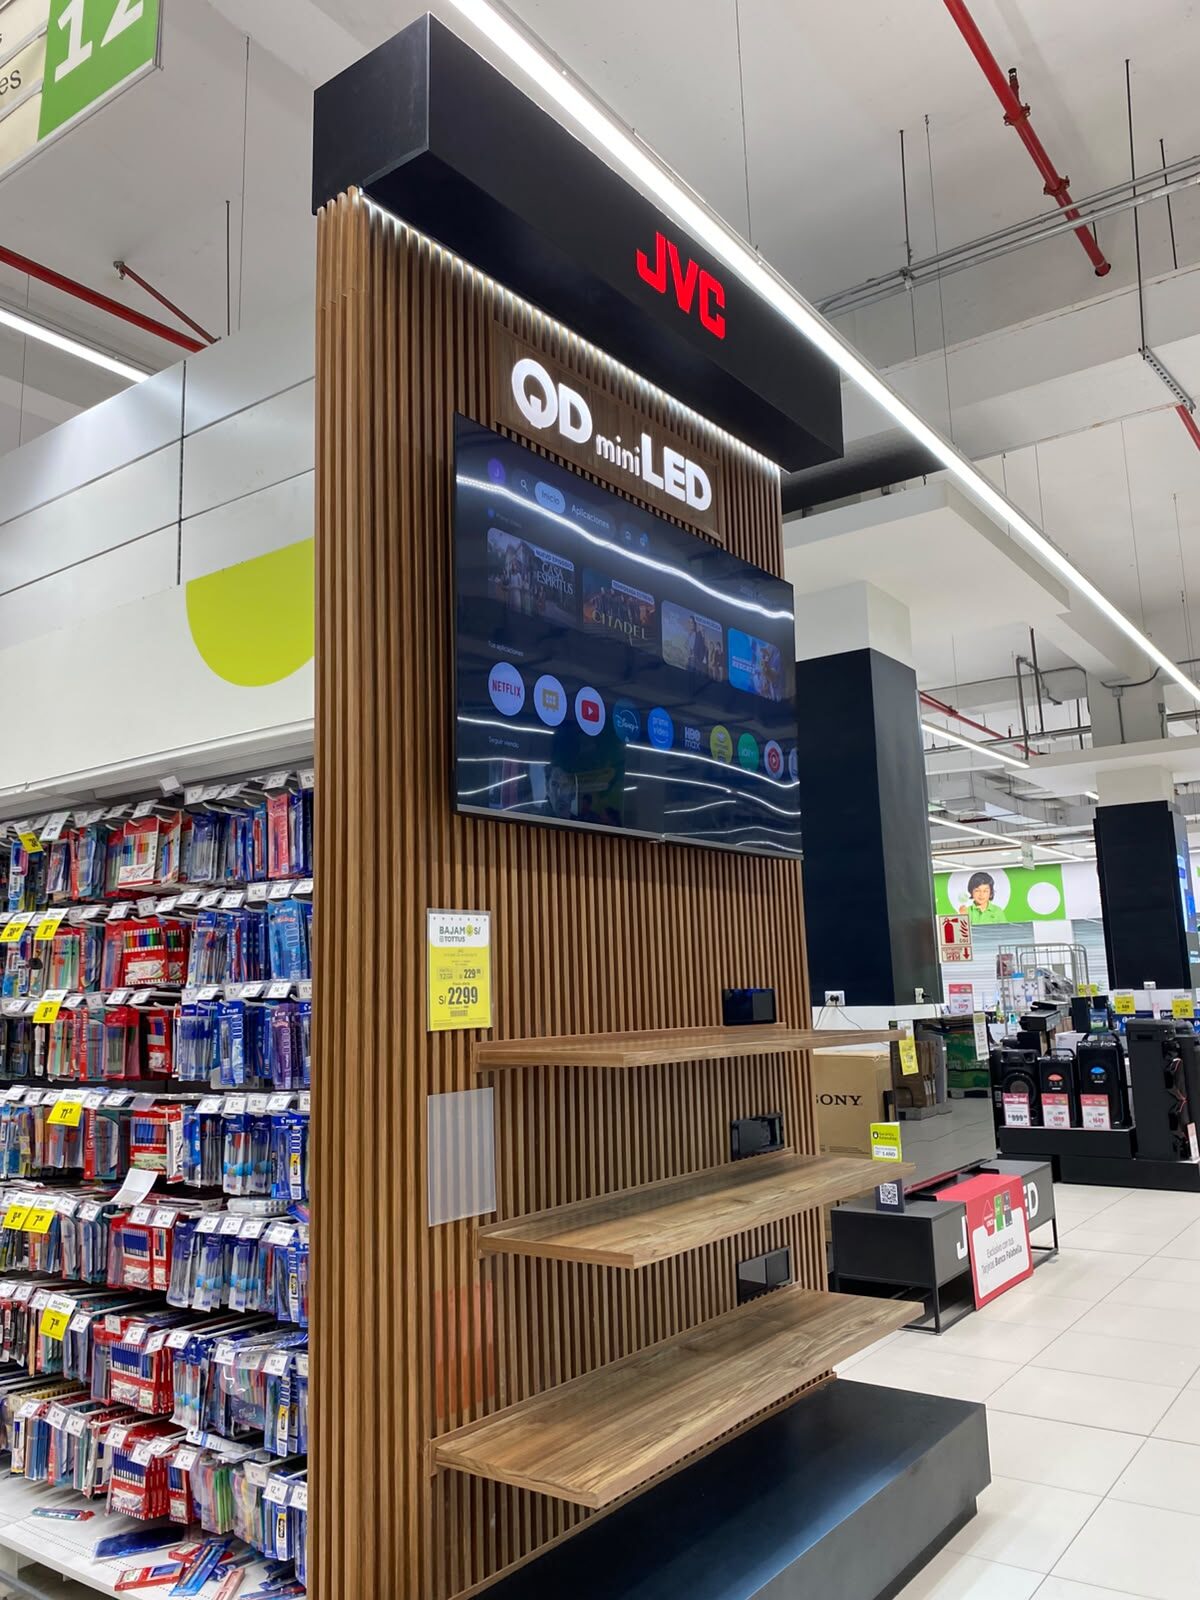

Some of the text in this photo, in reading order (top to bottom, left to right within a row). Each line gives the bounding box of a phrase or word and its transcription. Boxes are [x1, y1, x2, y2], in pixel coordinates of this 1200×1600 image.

[636, 231, 726, 340] JVC
[511, 357, 593, 444] QD
[571, 504, 610, 529] Aplicaciones
[591, 609, 648, 642] CITADEL
[491, 678, 522, 699] NETFLIX
[684, 726, 701, 742] HBO
[447, 986, 479, 1005] 2299
[994, 1253, 1006, 1268] Banco
[1006, 1244, 1023, 1262] Falabella
